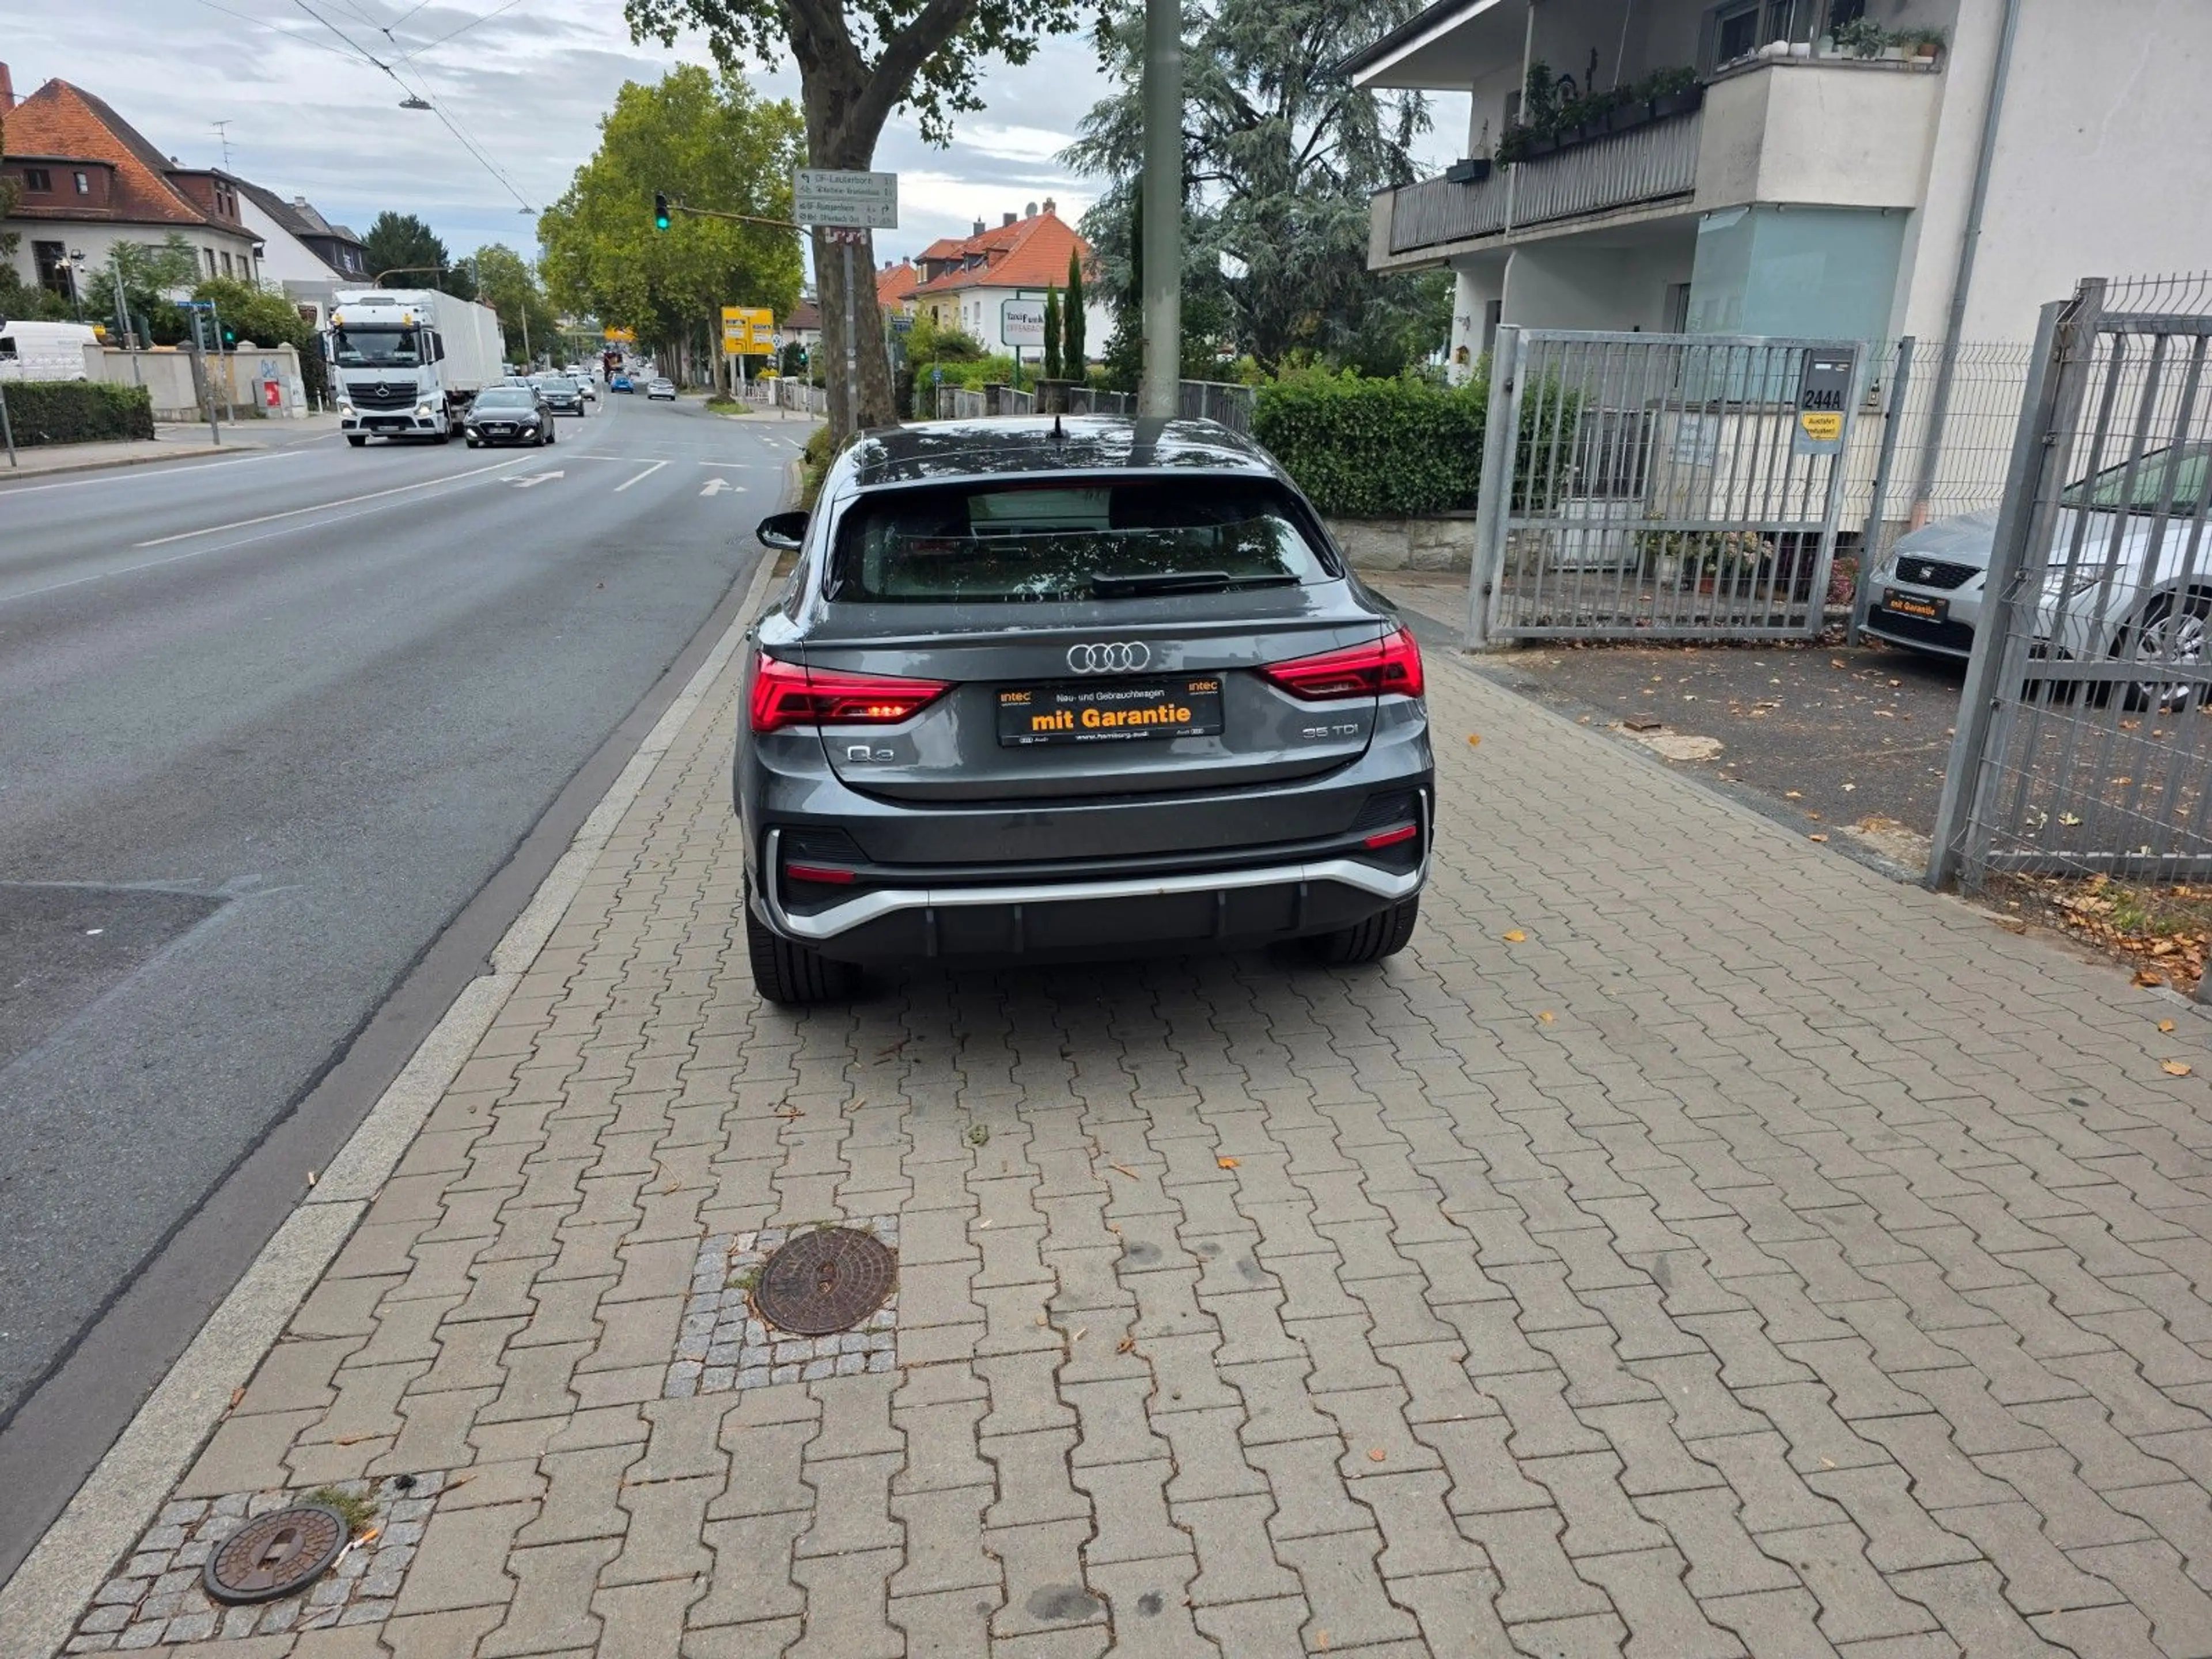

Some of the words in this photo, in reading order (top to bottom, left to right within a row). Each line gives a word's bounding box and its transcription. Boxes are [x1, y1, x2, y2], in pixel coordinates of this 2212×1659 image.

[1805, 389, 1840, 408] 244A
[1189, 681, 1217, 691] intec
[1001, 692, 1031, 702] intec
[1056, 694, 1076, 702] Neu-
[1078, 693, 1094, 701] und
[1096, 690, 1165, 700] Gebrauchtwagen
[1032, 709, 1074, 730] mit
[1082, 703, 1191, 728] Garantie
[1332, 724, 1358, 735] TDI
[847, 745, 894, 762] Q3
